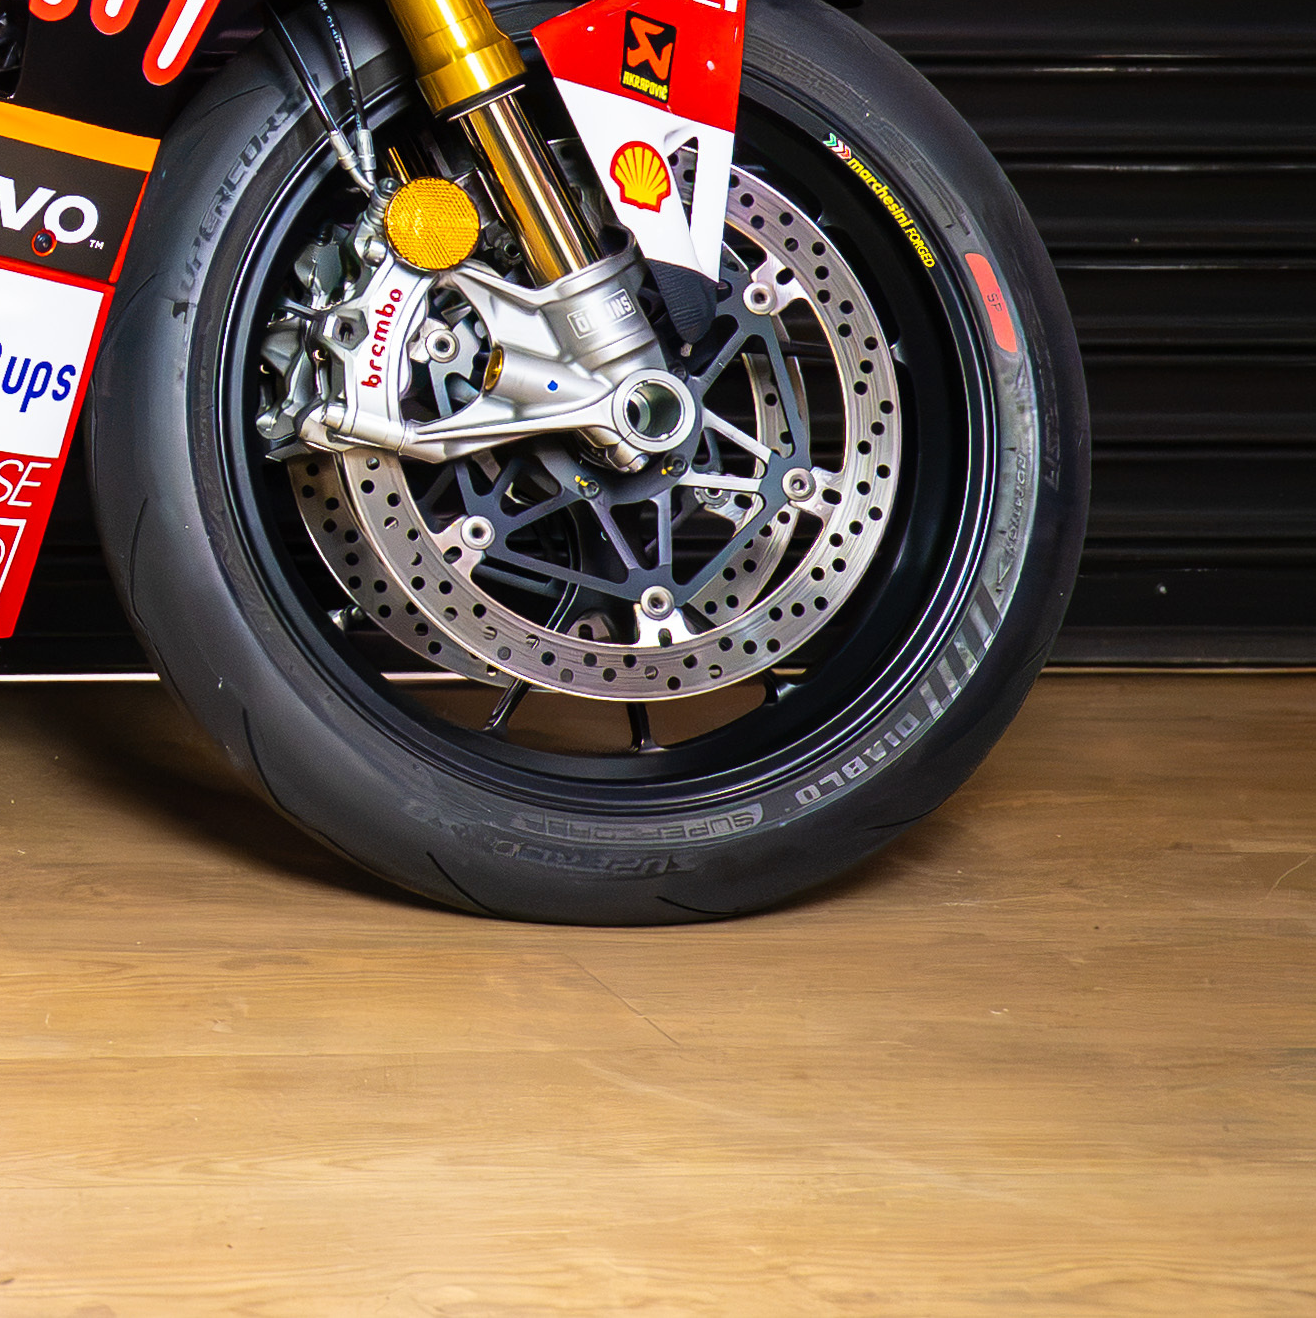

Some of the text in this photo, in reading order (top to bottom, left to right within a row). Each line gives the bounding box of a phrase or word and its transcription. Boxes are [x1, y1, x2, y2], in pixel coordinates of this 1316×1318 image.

[846, 157, 936, 268] marchesini FORGED
[360, 288, 404, 389] brembo
[572, 295, 633, 334] ÖINS
[795, 711, 921, 806] DIABLO
